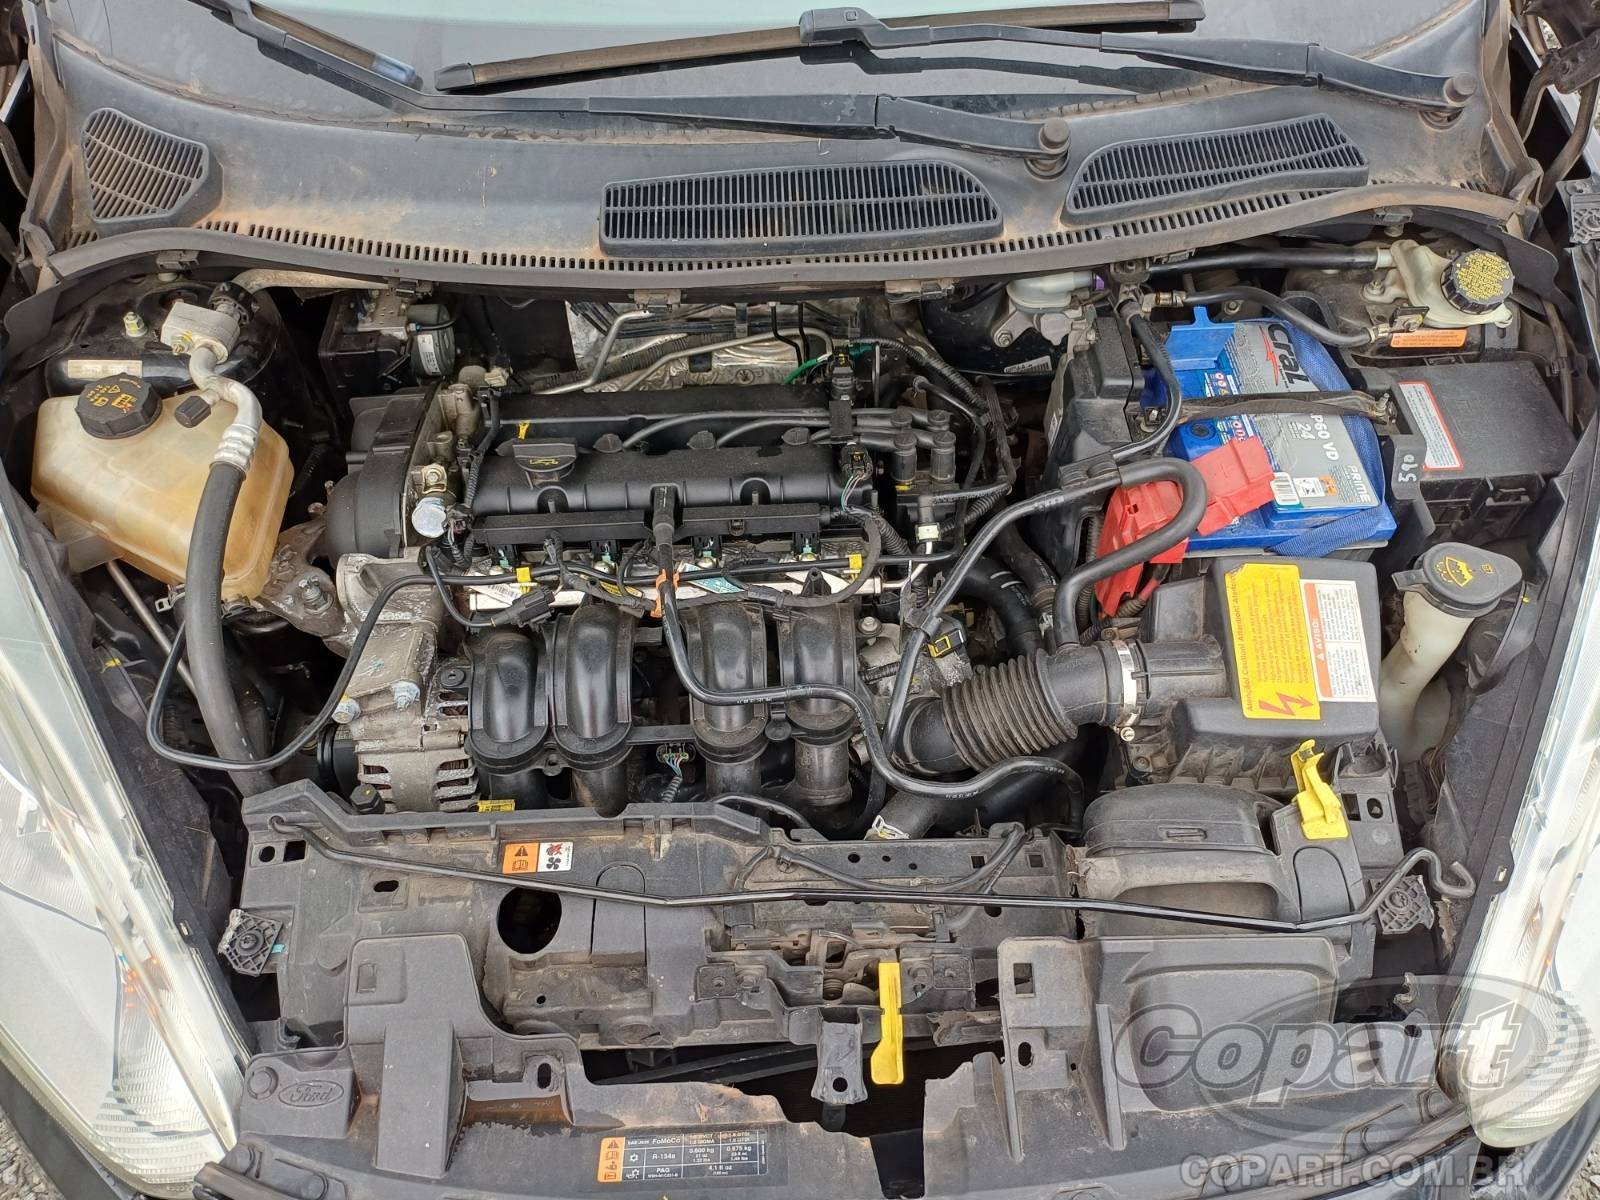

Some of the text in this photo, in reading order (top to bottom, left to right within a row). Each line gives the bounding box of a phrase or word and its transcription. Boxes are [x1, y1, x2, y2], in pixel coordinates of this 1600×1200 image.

[1297, 422, 1316, 440] 24
[1310, 413, 1339, 461] P60 VD
[1348, 465, 1371, 503] PRIME
[289, 1083, 333, 1103] Ford
